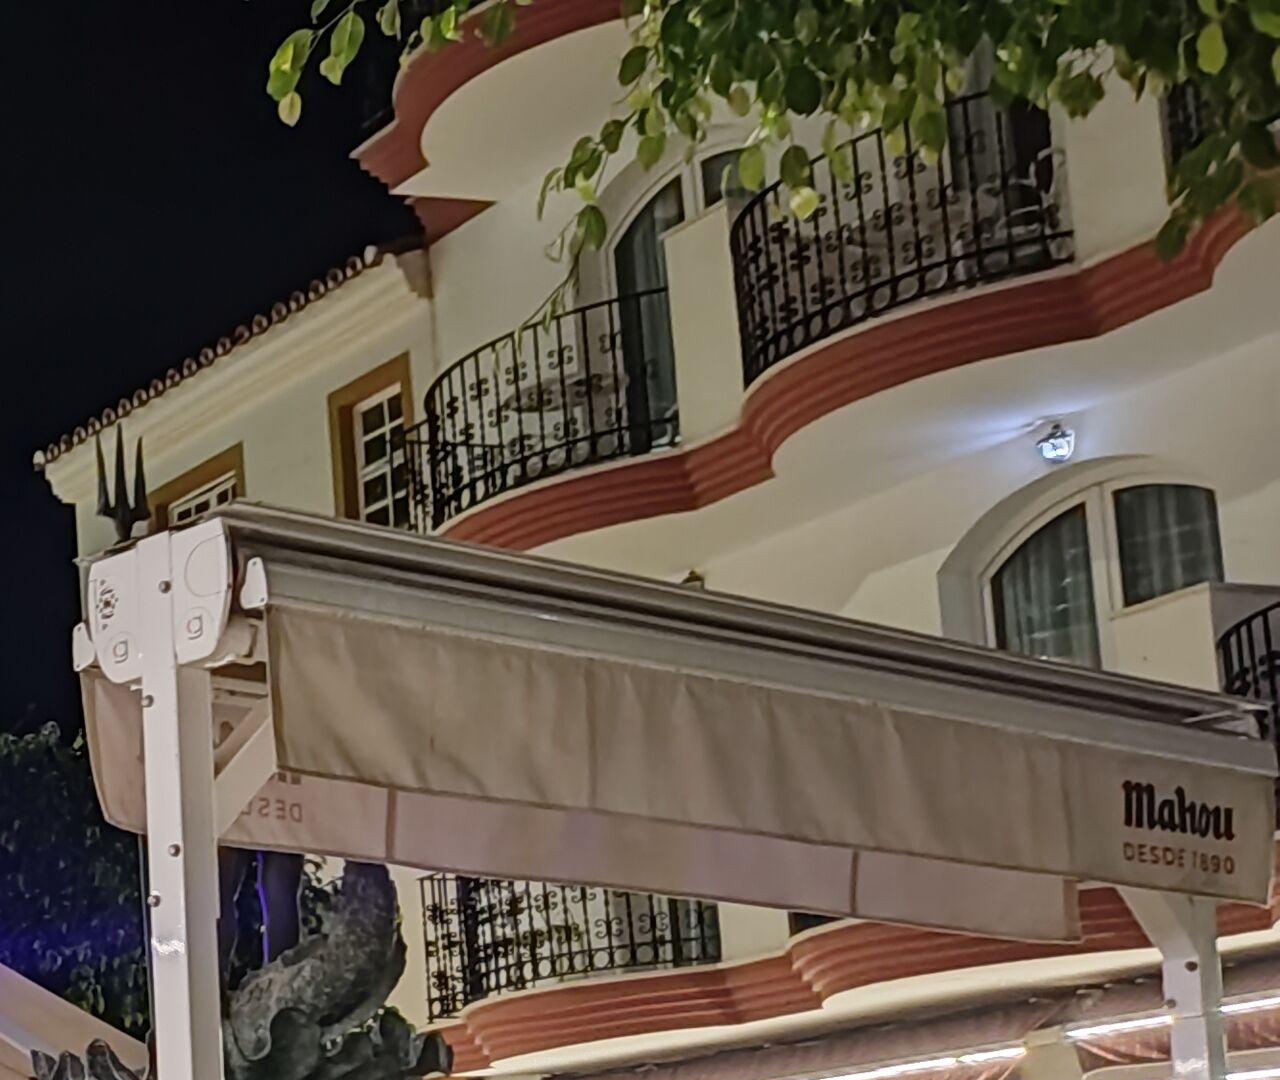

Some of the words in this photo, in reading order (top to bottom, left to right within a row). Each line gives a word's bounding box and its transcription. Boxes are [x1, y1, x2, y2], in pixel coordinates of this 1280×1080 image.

[1122, 779, 1236, 841] Mahou
[1122, 842, 1186, 868] DESDE
[1192, 851, 1236, 875] 1890
